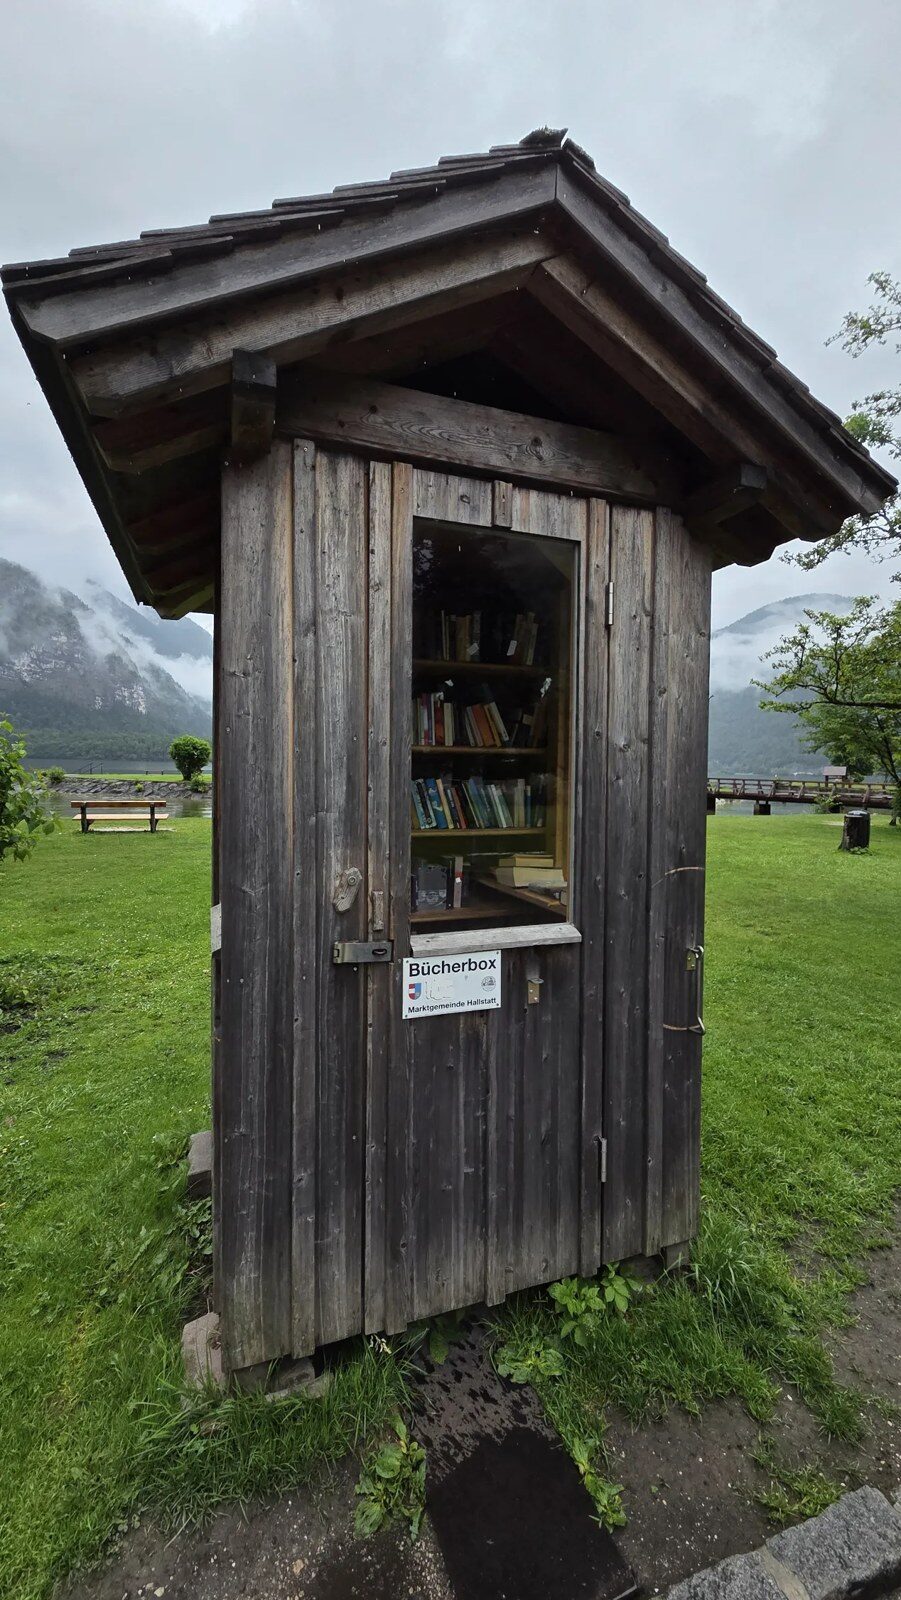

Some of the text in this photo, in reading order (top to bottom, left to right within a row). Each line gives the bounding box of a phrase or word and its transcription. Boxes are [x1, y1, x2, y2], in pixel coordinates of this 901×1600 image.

[409, 958, 497, 977] Bücherbox
[408, 998, 497, 1013] Marktgemeinde Hallstatt
